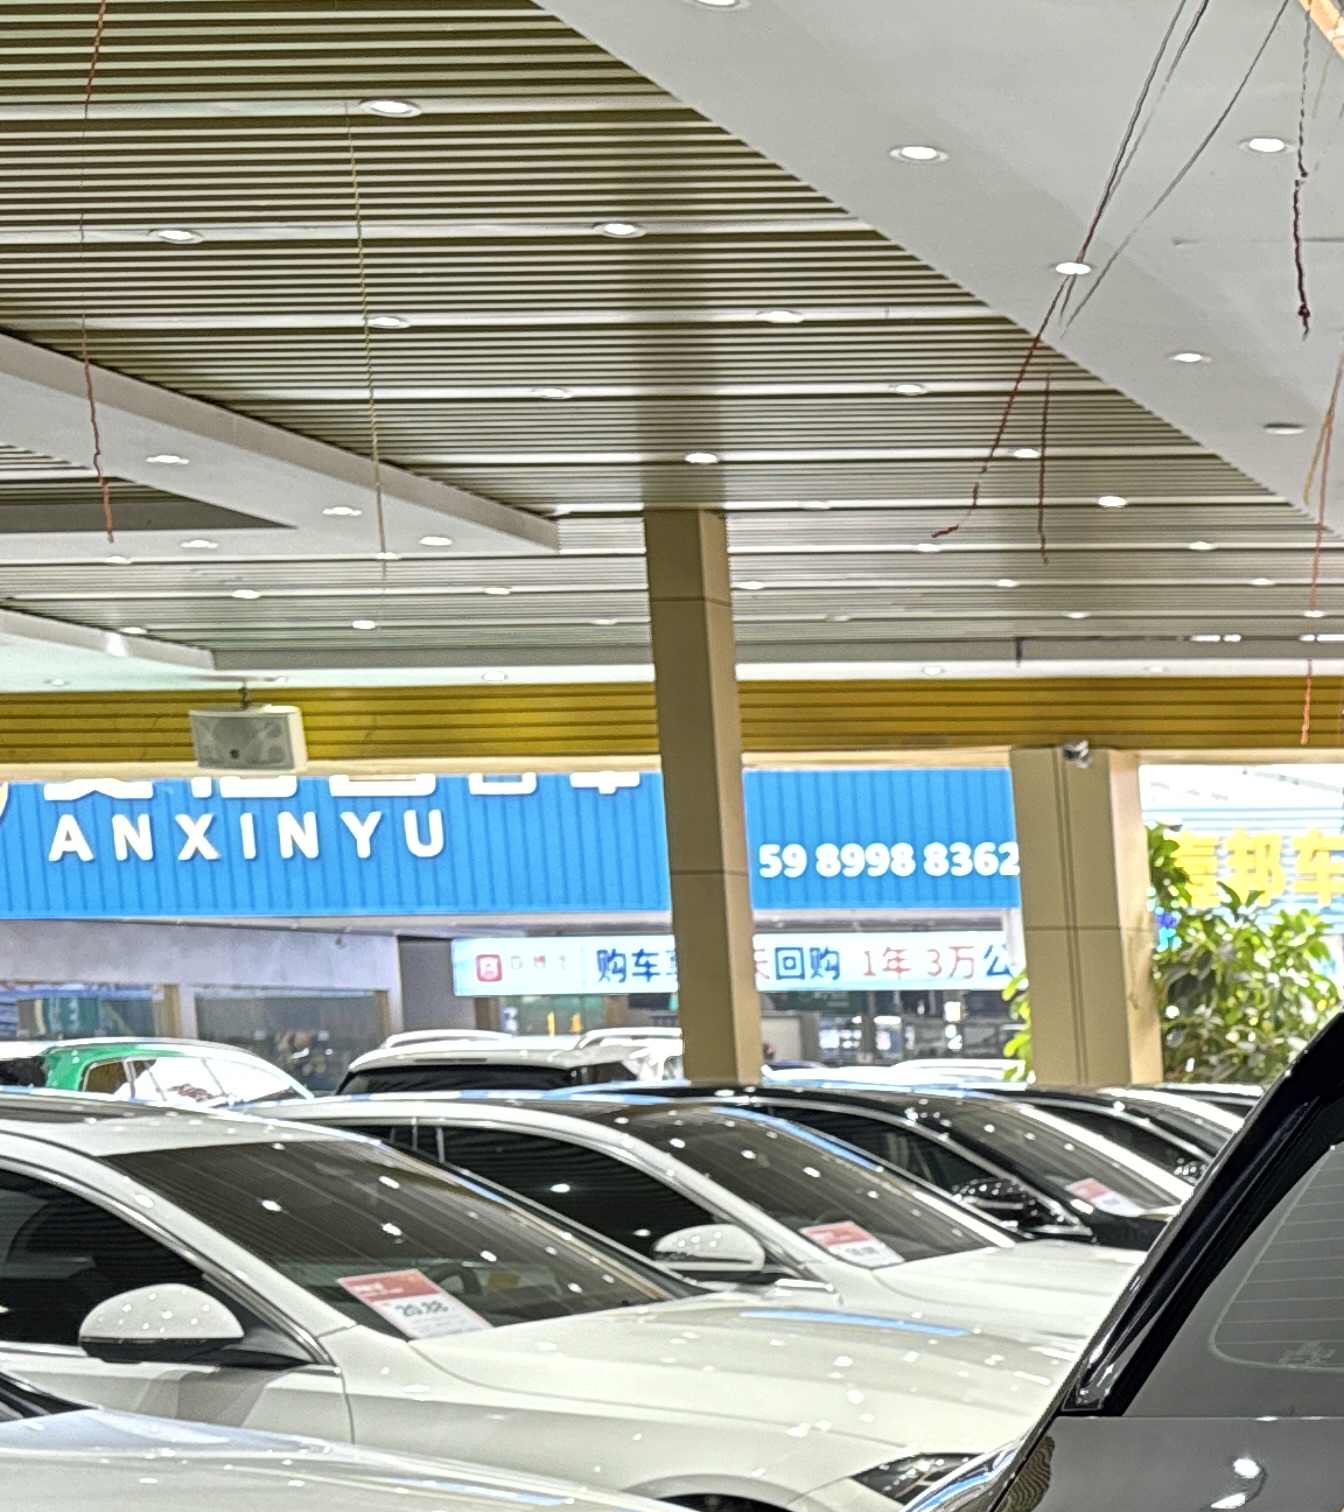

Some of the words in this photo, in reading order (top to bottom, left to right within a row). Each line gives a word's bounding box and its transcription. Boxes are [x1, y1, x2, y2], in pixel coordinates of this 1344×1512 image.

[48, 809, 444, 862] ANXINYU
[759, 843, 807, 878] 59
[815, 843, 916, 877] 8998
[924, 842, 1020, 876] 8362
[596, 949, 677, 983] 购车
[863, 947, 911, 977] 1年
